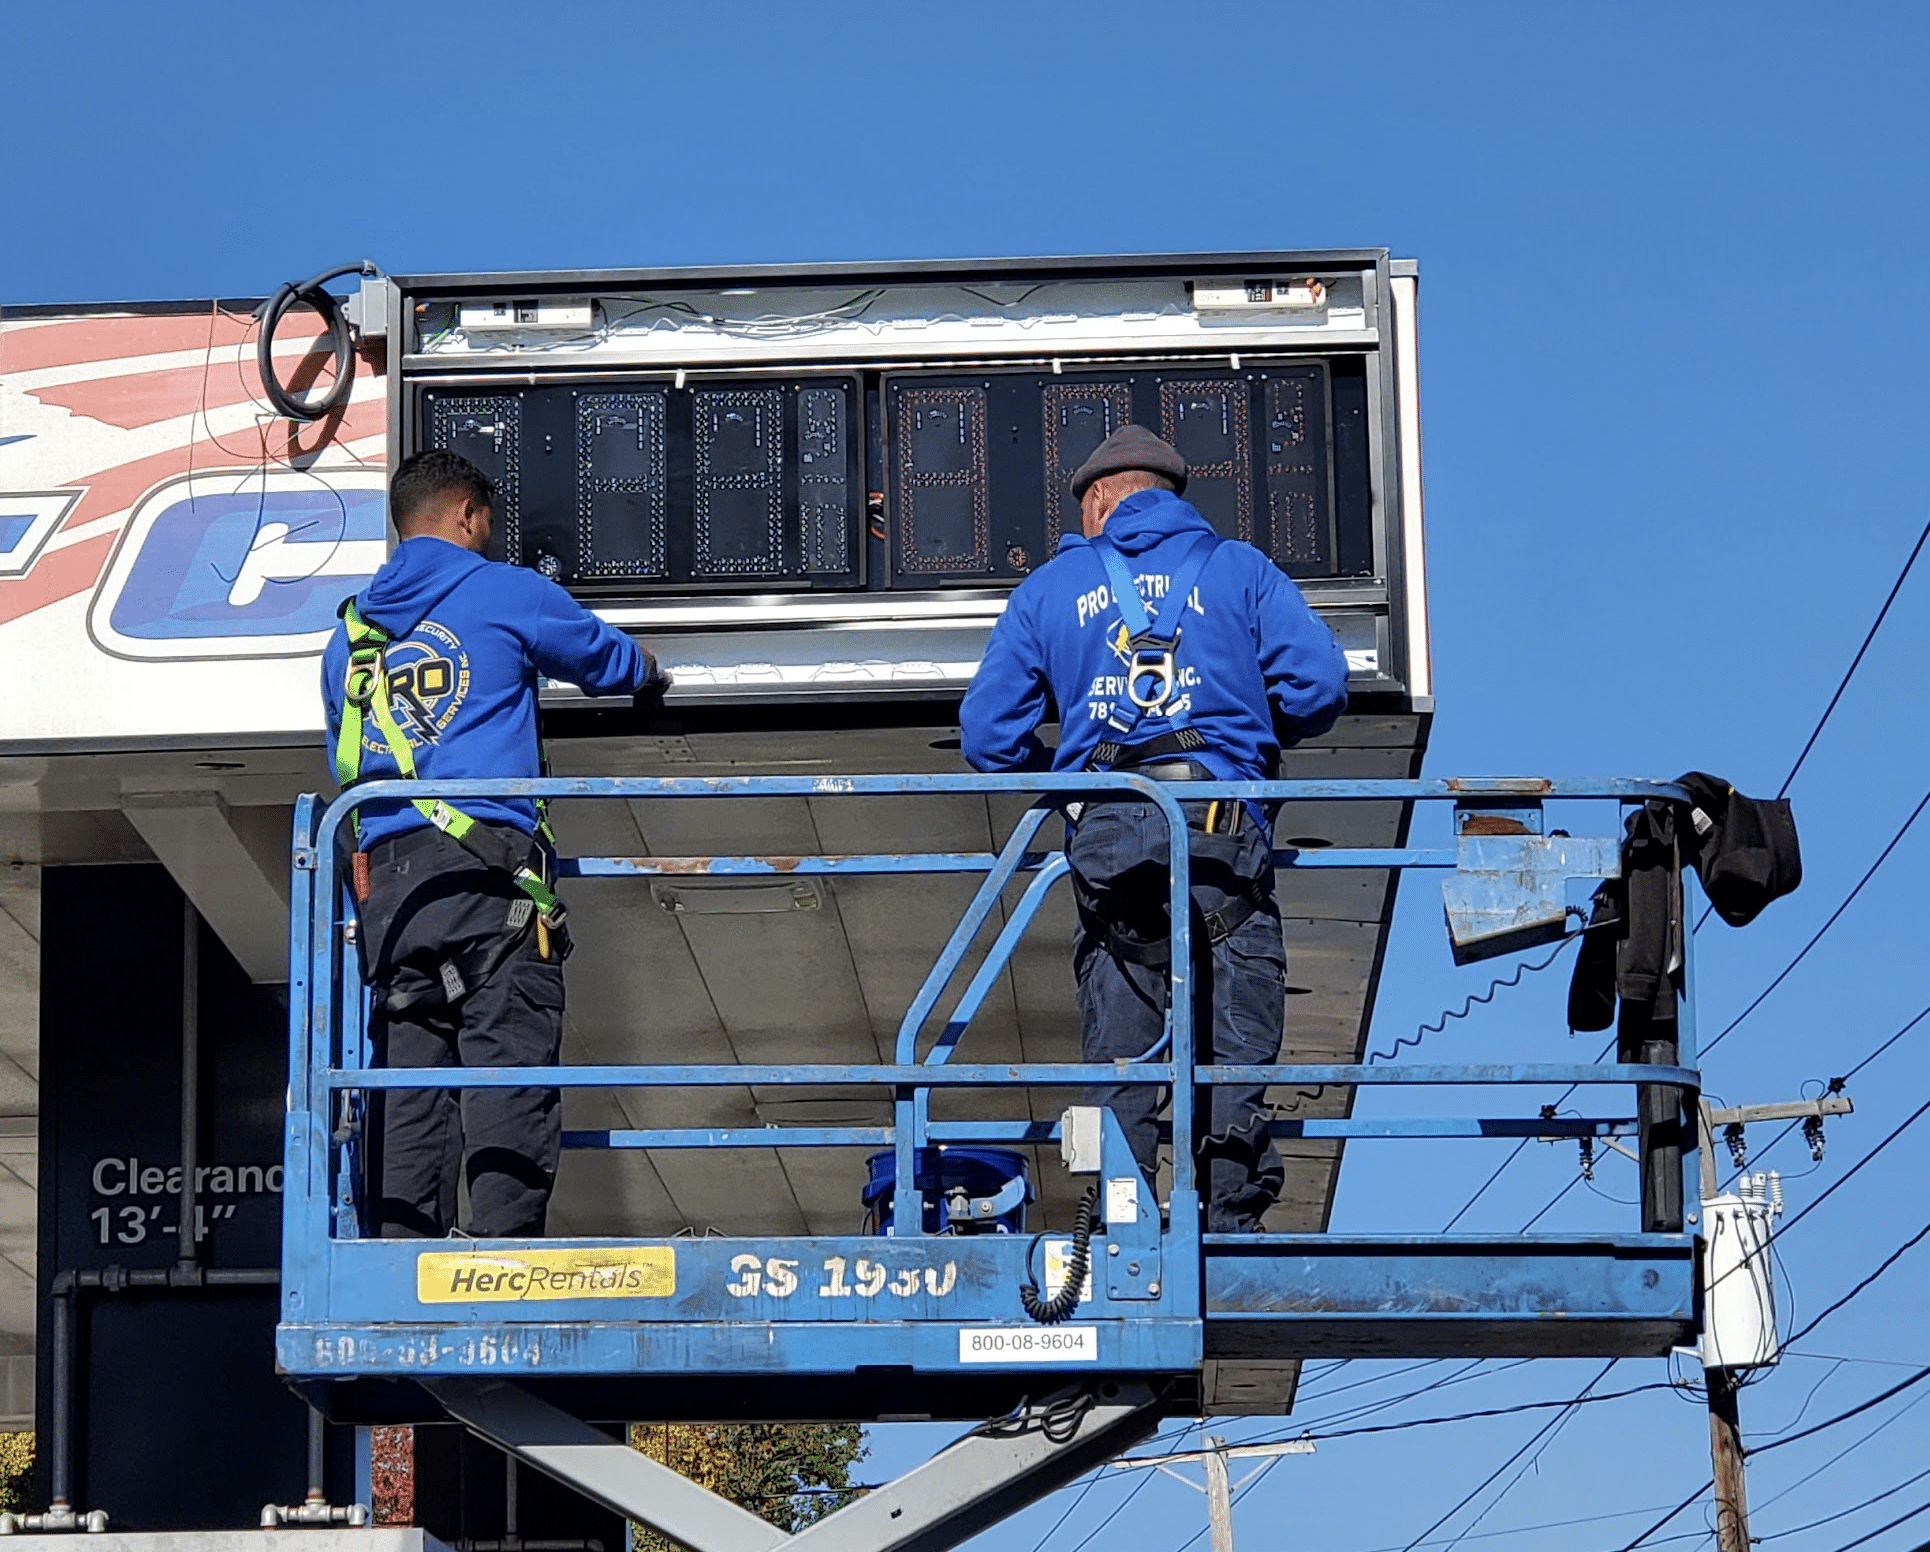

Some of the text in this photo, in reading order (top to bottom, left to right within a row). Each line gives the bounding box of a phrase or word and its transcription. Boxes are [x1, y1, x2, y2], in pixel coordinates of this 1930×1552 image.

[1076, 583, 1108, 628] PRO
[386, 657, 454, 700] RO
[436, 669, 471, 729] SERVICES
[92, 1157, 284, 1196] Clearanc
[726, 1254, 799, 1297] GS
[971, 1333, 1085, 1351] 800-08-9604
